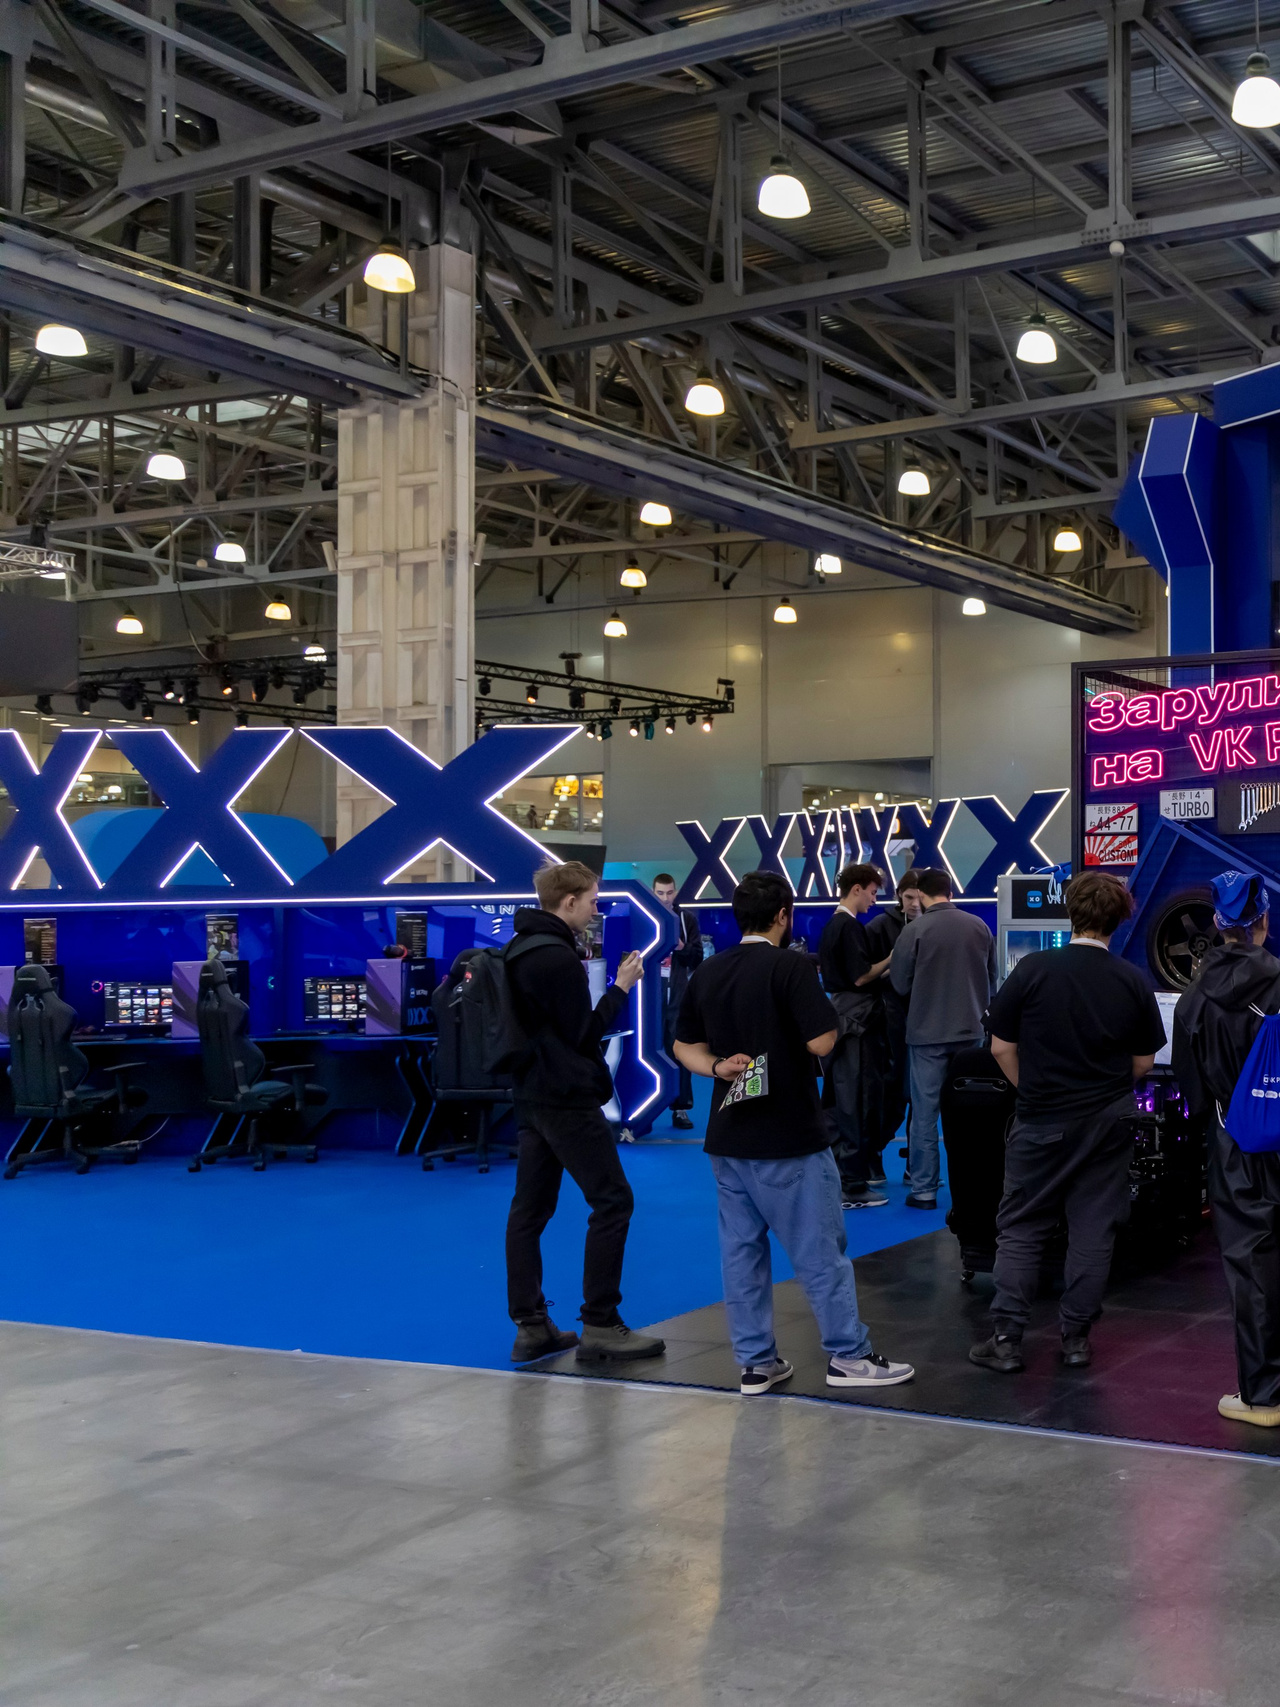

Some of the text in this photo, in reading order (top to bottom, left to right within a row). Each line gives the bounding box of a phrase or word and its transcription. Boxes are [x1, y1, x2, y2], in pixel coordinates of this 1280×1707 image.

[1092, 748, 1163, 788] на
[1188, 725, 1257, 772] VK
[1172, 801, 1210, 817] TURBO
[1097, 816, 1134, 831] 44-77
[1098, 850, 1134, 863] CUSTOM
